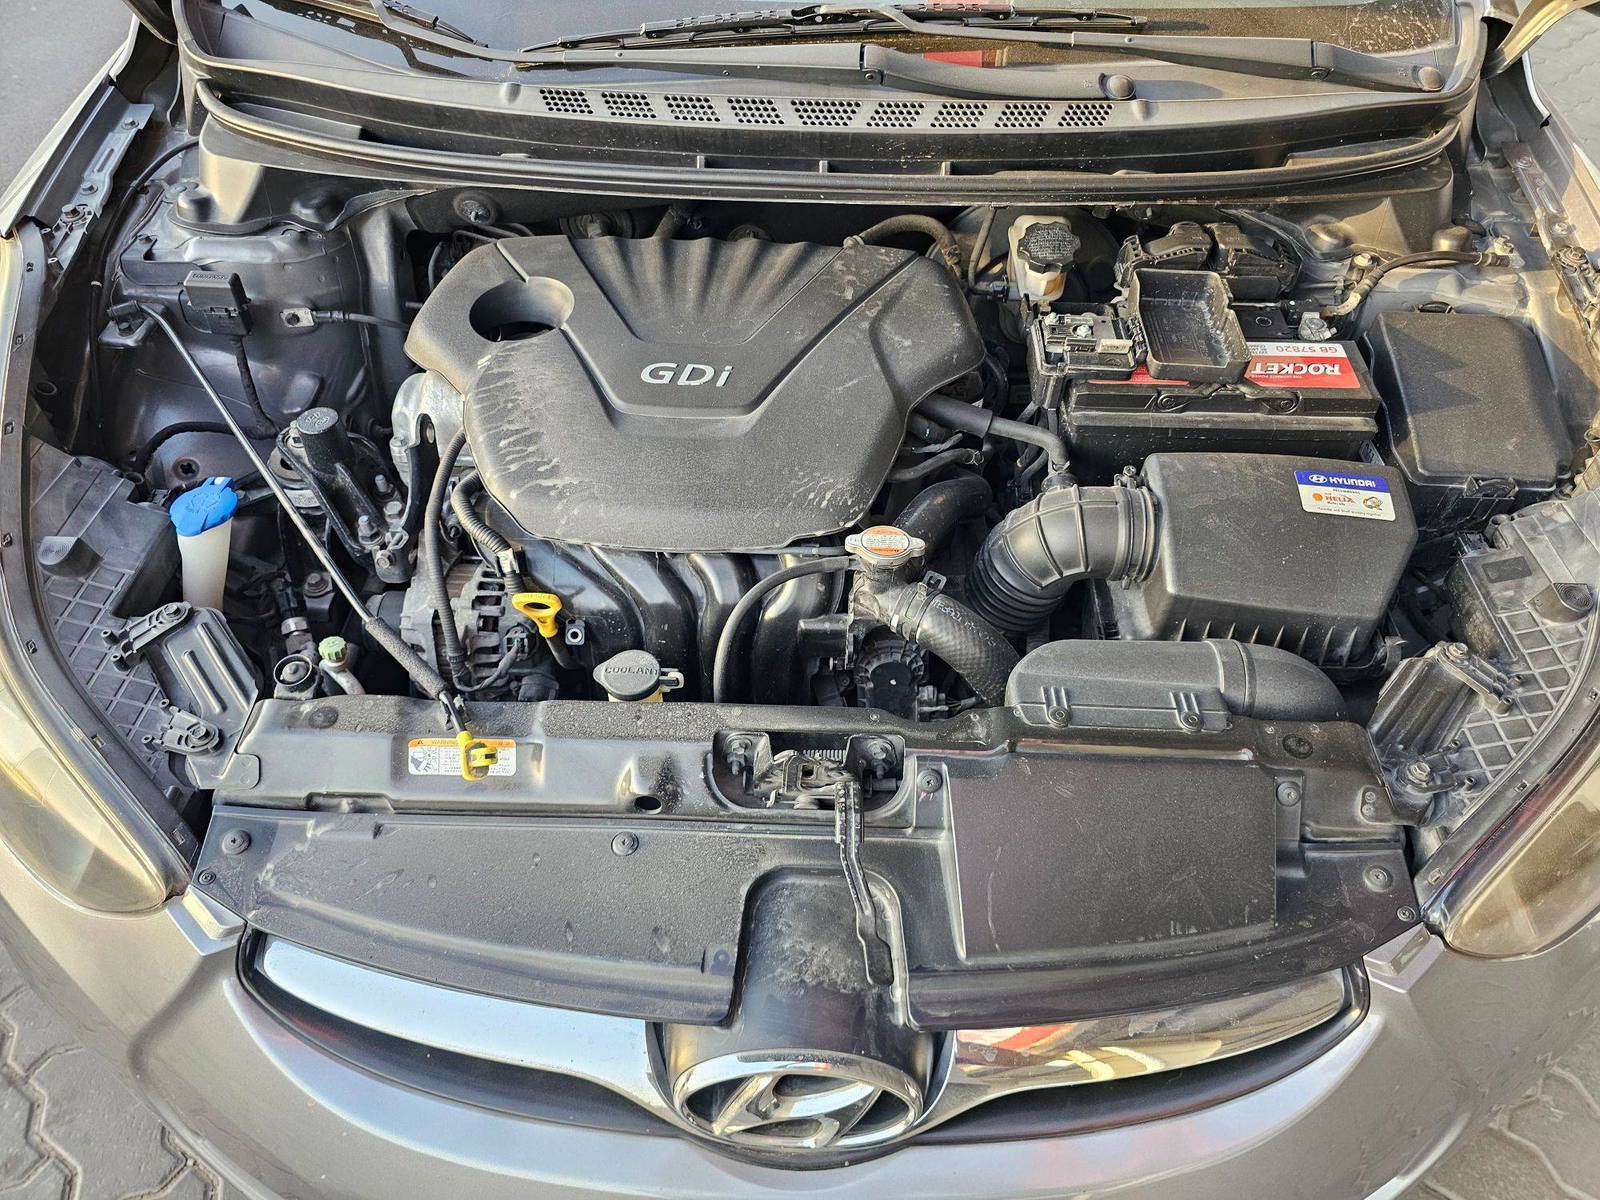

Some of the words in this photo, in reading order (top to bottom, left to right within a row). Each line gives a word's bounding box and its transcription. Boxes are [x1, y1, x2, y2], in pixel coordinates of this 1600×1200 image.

[1320, 345, 1337, 353] GB
[640, 362, 733, 387] GDi
[1251, 362, 1342, 375] ROCKET
[1329, 476, 1376, 488] HYUNDAI
[605, 666, 658, 675] COOLANT
